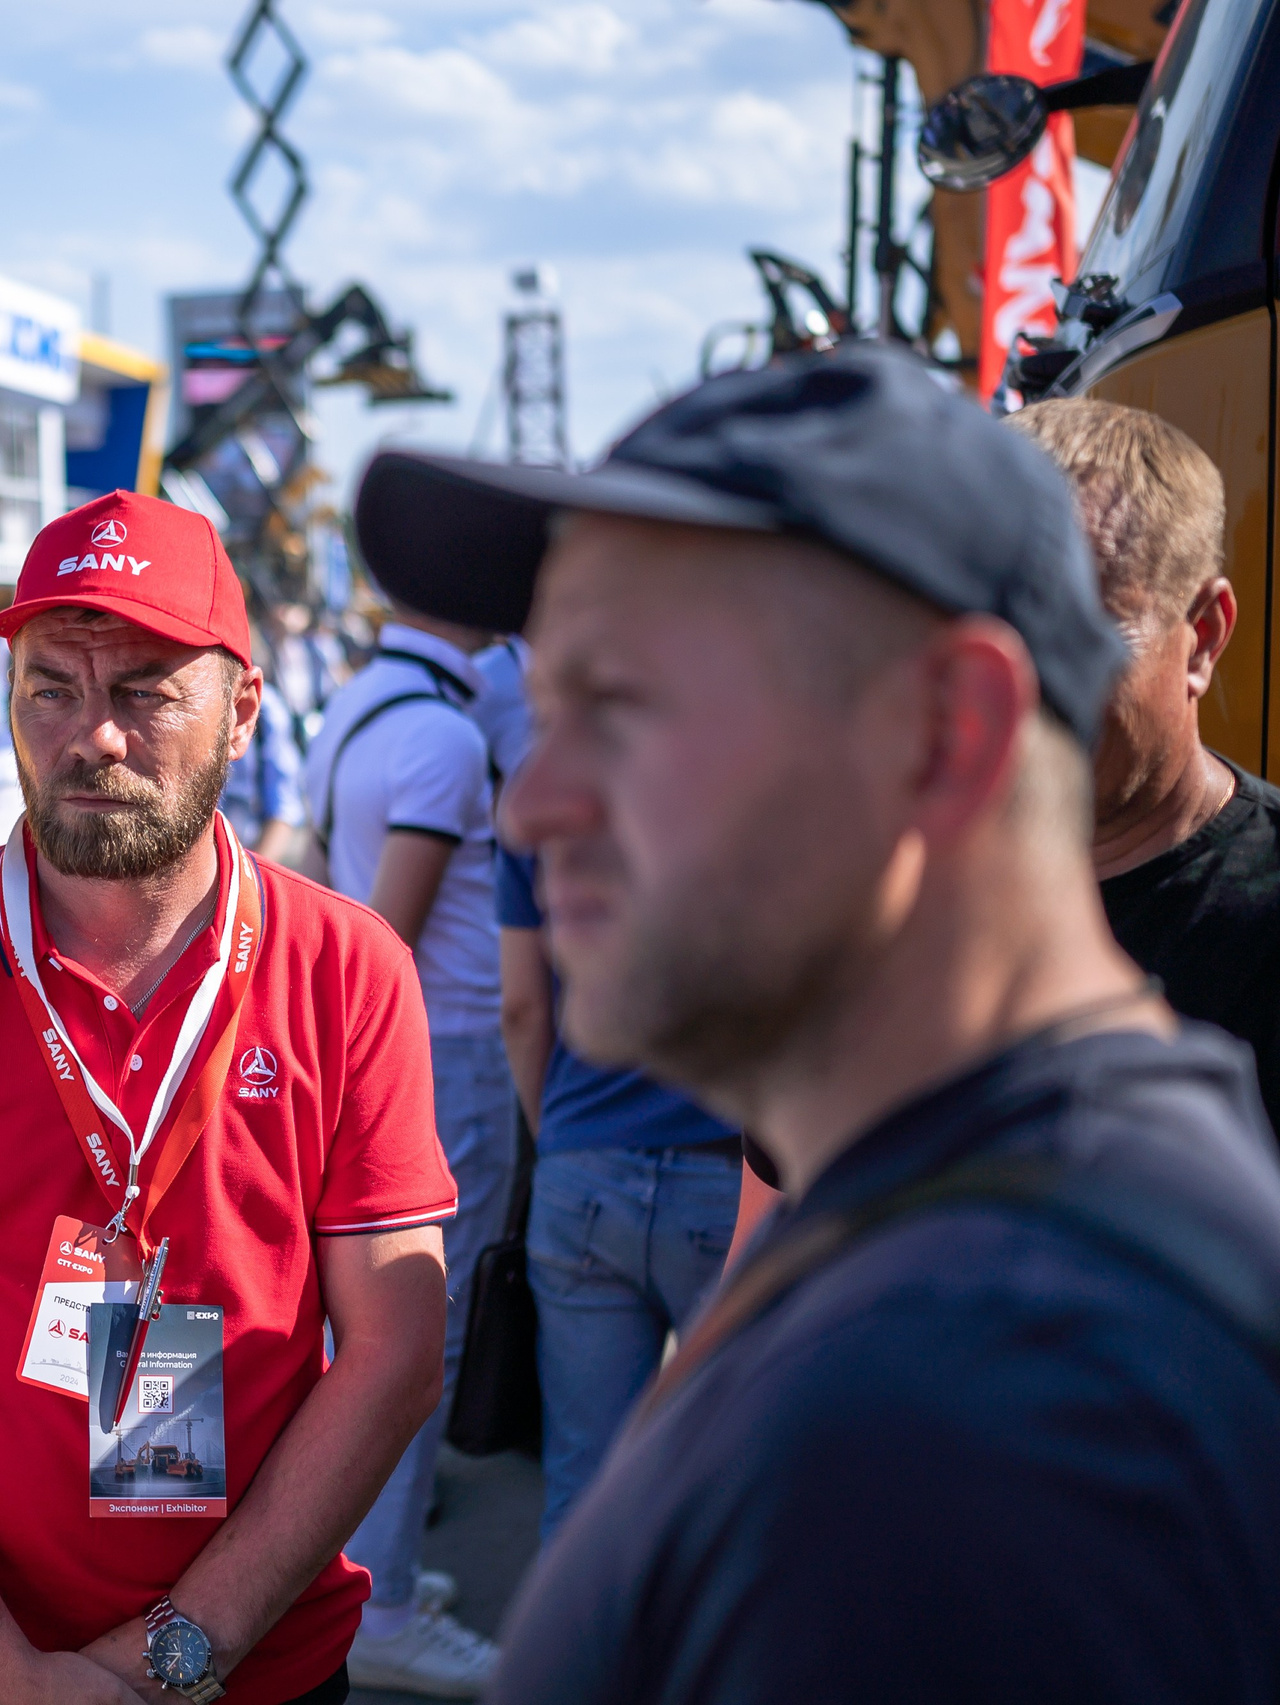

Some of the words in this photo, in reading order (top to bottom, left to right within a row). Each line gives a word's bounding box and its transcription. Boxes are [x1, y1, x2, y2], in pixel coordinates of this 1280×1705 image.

[56, 553, 151, 576] SANY
[234, 922, 254, 974] SANY
[42, 1028, 75, 1082] SANY
[238, 1087, 279, 1098] SANY
[85, 1132, 120, 1187] SANY
[74, 1247, 105, 1263] SANY
[54, 1296, 90, 1313] ПРЕДСТА
[68, 1328, 90, 1344] SA
[147, 1350, 197, 1360] информация
[149, 1361, 193, 1369] Information
[60, 1374, 79, 1386] 2024
[109, 1504, 159, 1512] Экспонент
[166, 1503, 207, 1513] Exhibitor
